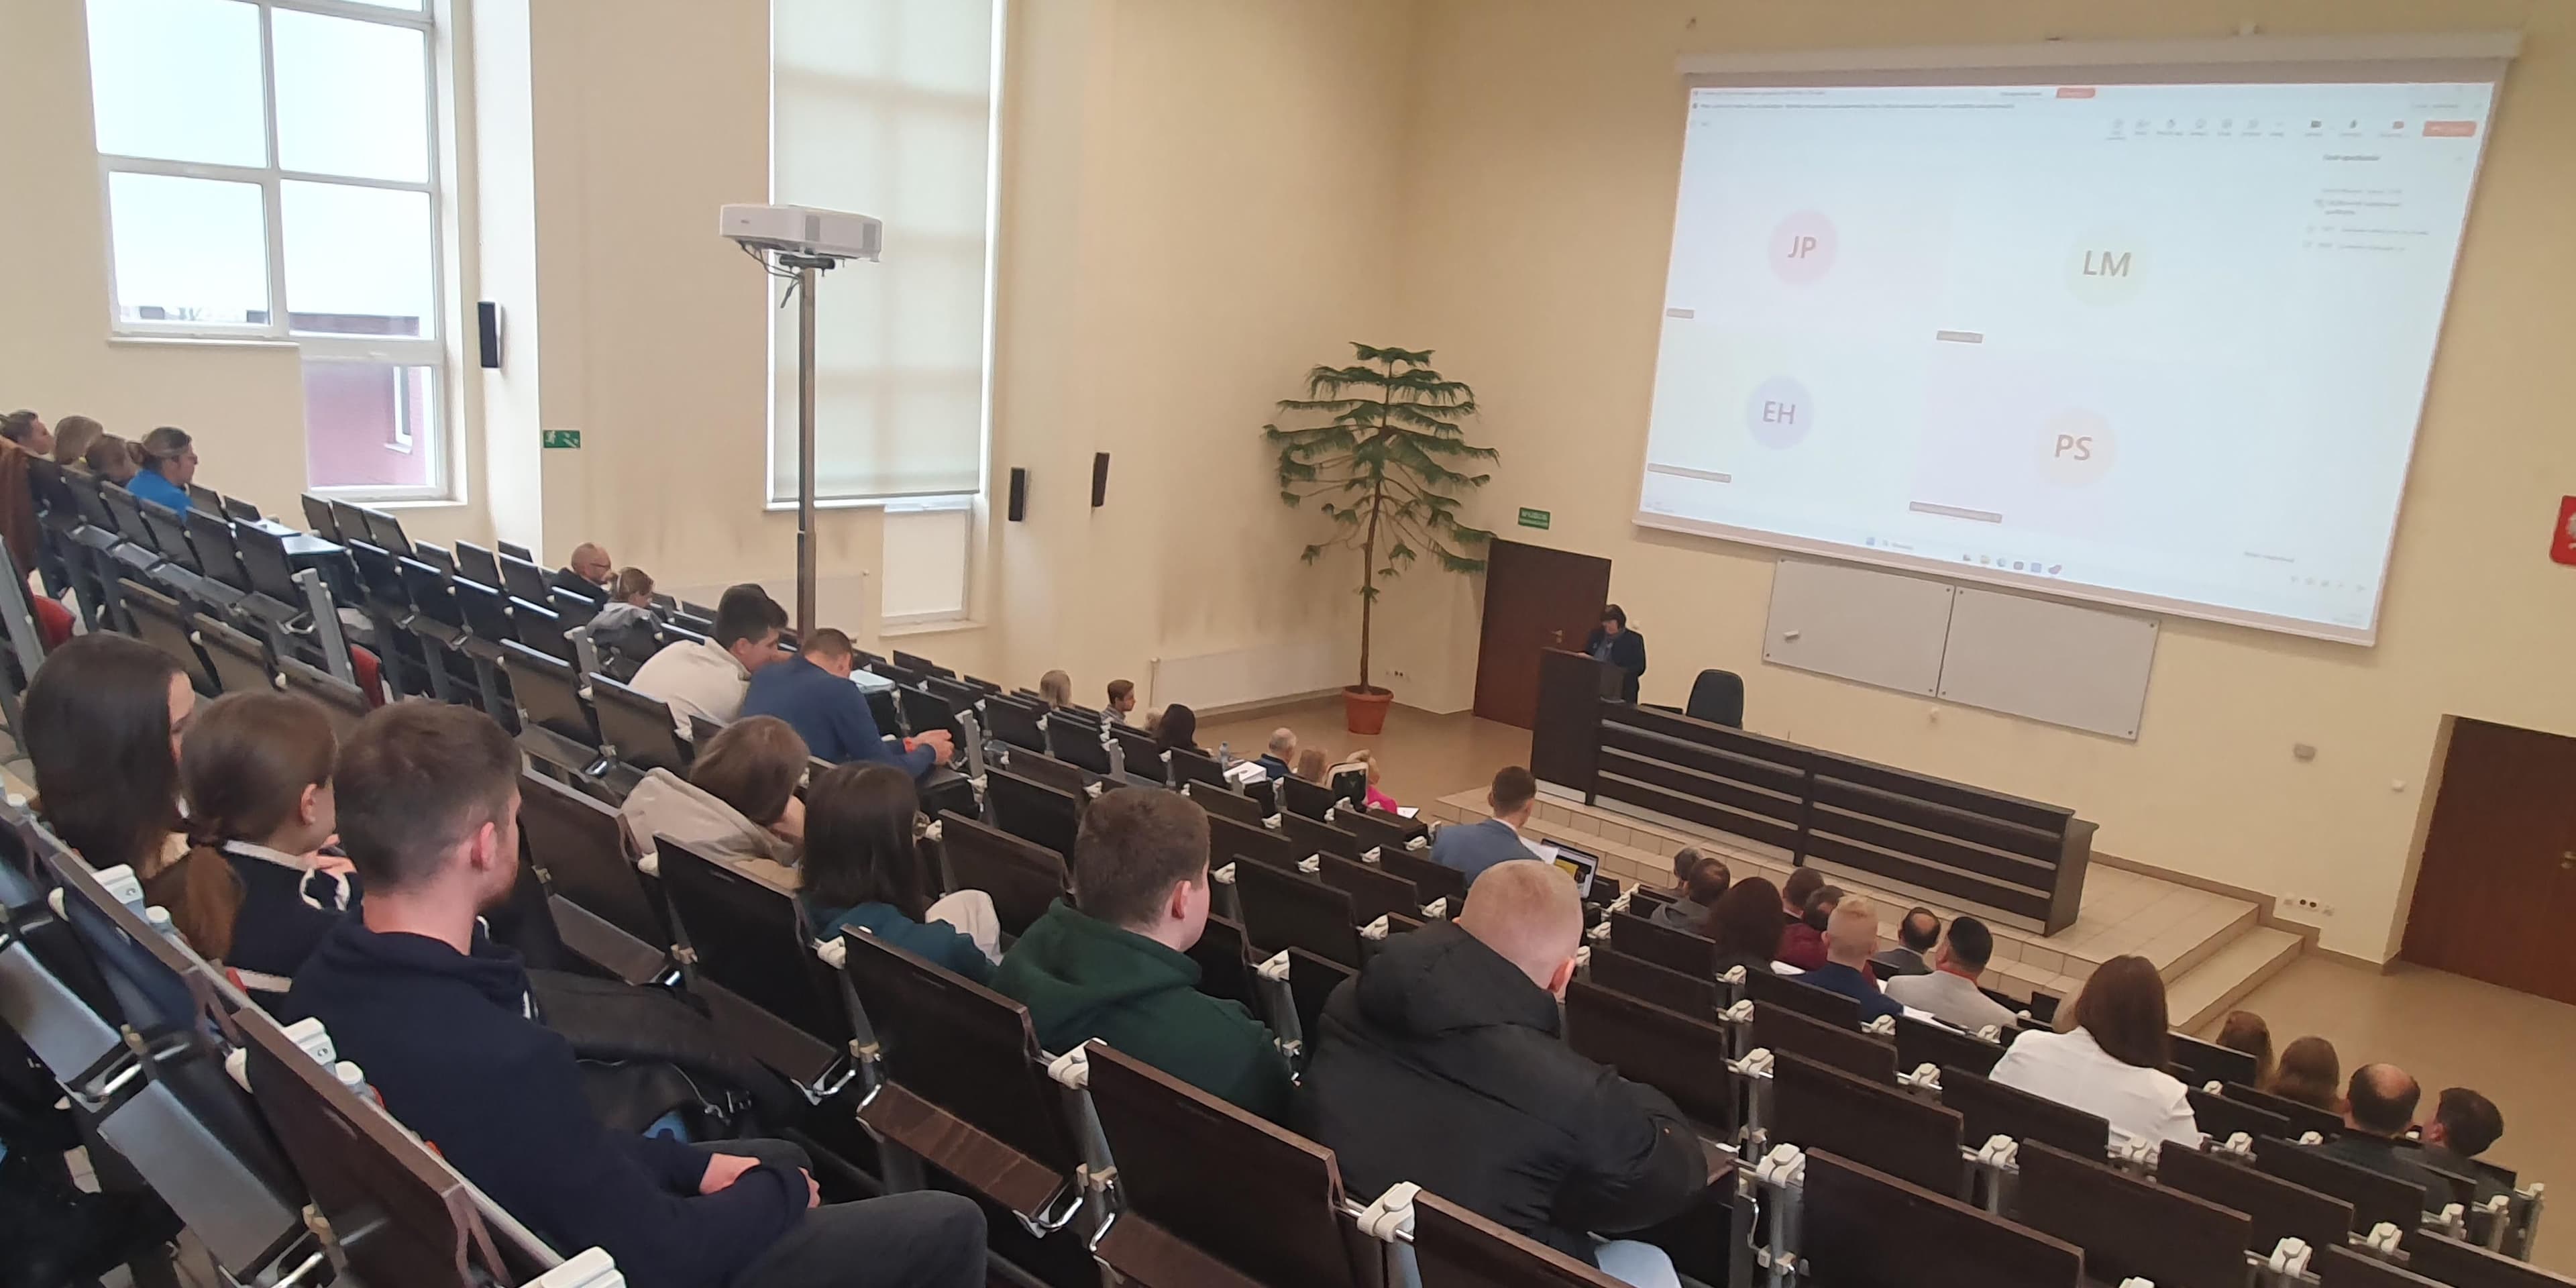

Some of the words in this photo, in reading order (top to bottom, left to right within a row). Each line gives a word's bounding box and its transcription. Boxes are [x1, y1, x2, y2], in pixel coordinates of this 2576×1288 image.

[1787, 235, 1817, 259] JP
[2083, 250, 2132, 277] LM
[1763, 400, 1796, 425] EH
[2055, 434, 2092, 461] PS
